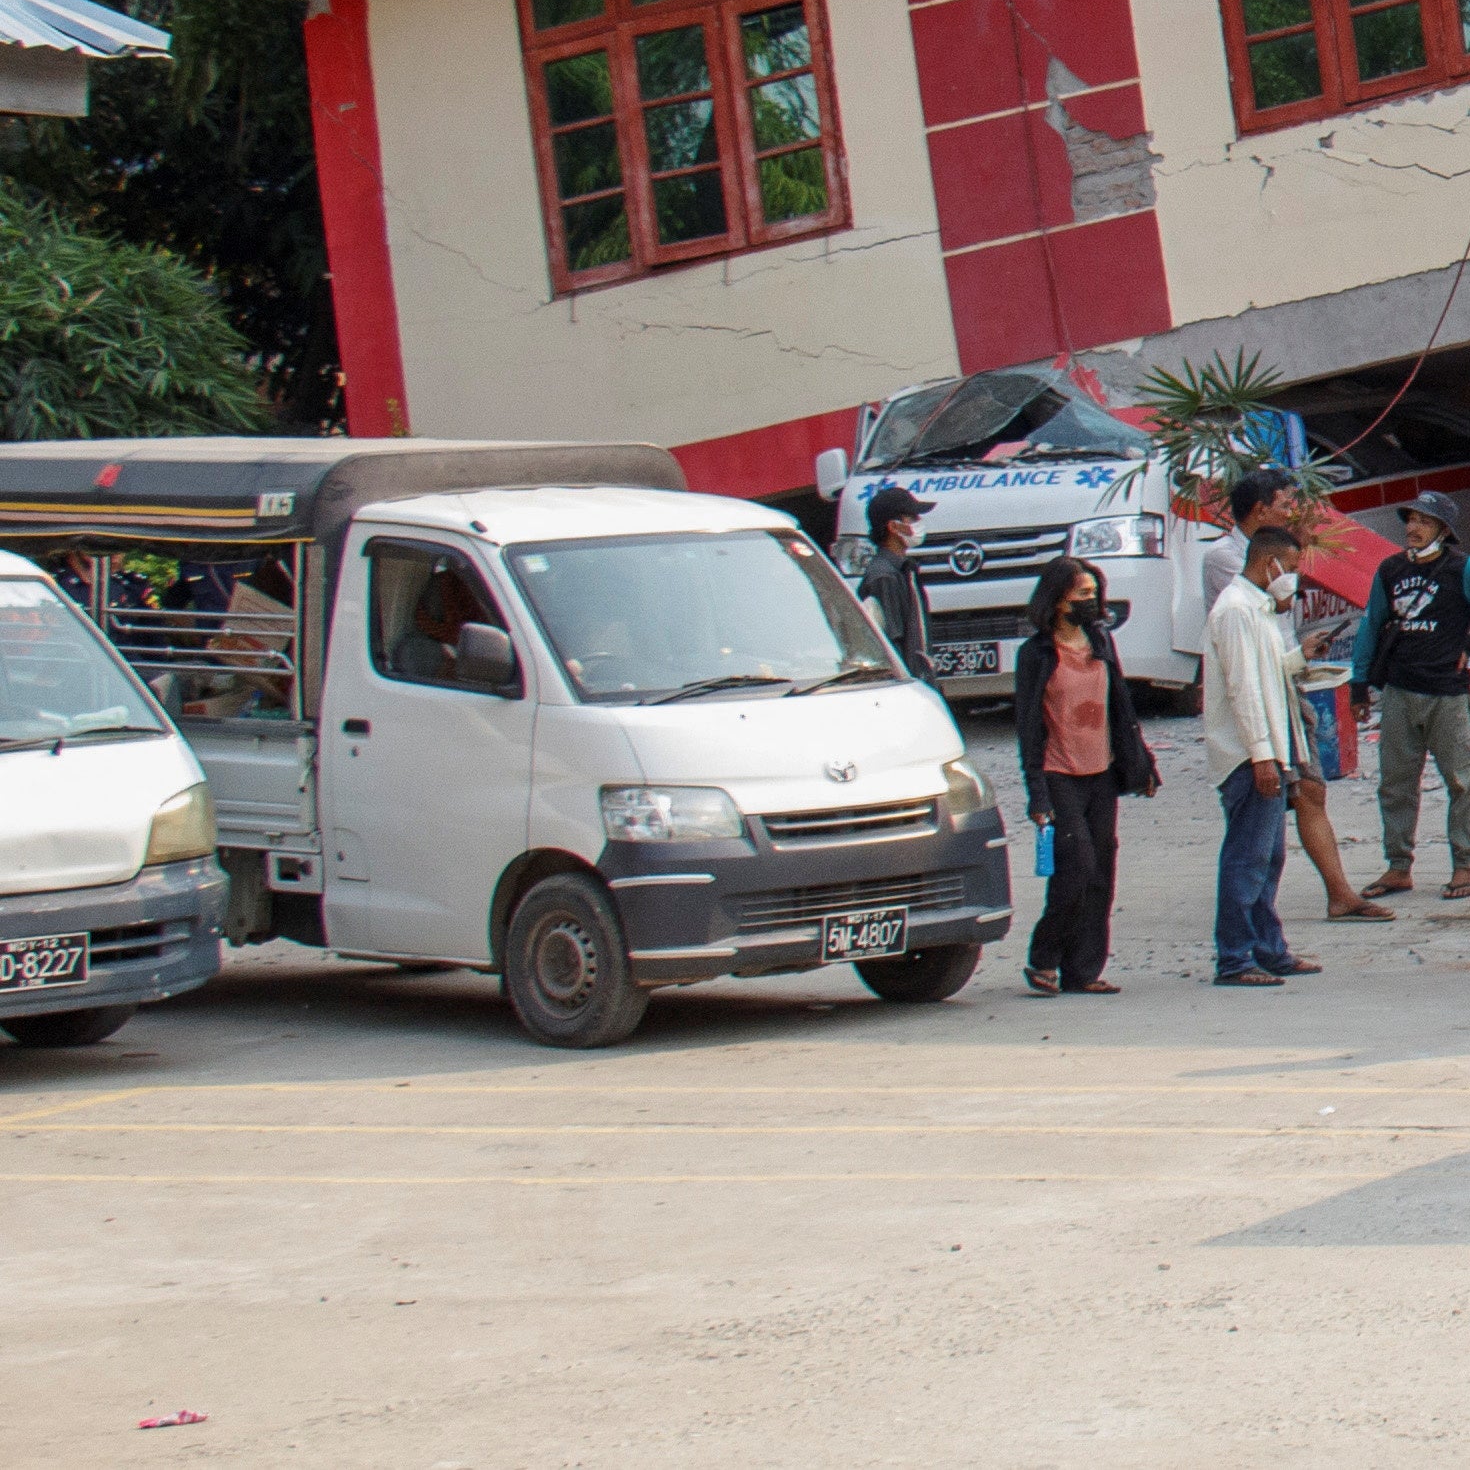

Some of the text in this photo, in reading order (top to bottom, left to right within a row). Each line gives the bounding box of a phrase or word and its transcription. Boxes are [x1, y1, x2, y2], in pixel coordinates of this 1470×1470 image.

[906, 469, 1067, 495] AMBULANCE
[1393, 575, 1440, 596] CUSTM
[827, 919, 904, 953] 5M-4807
